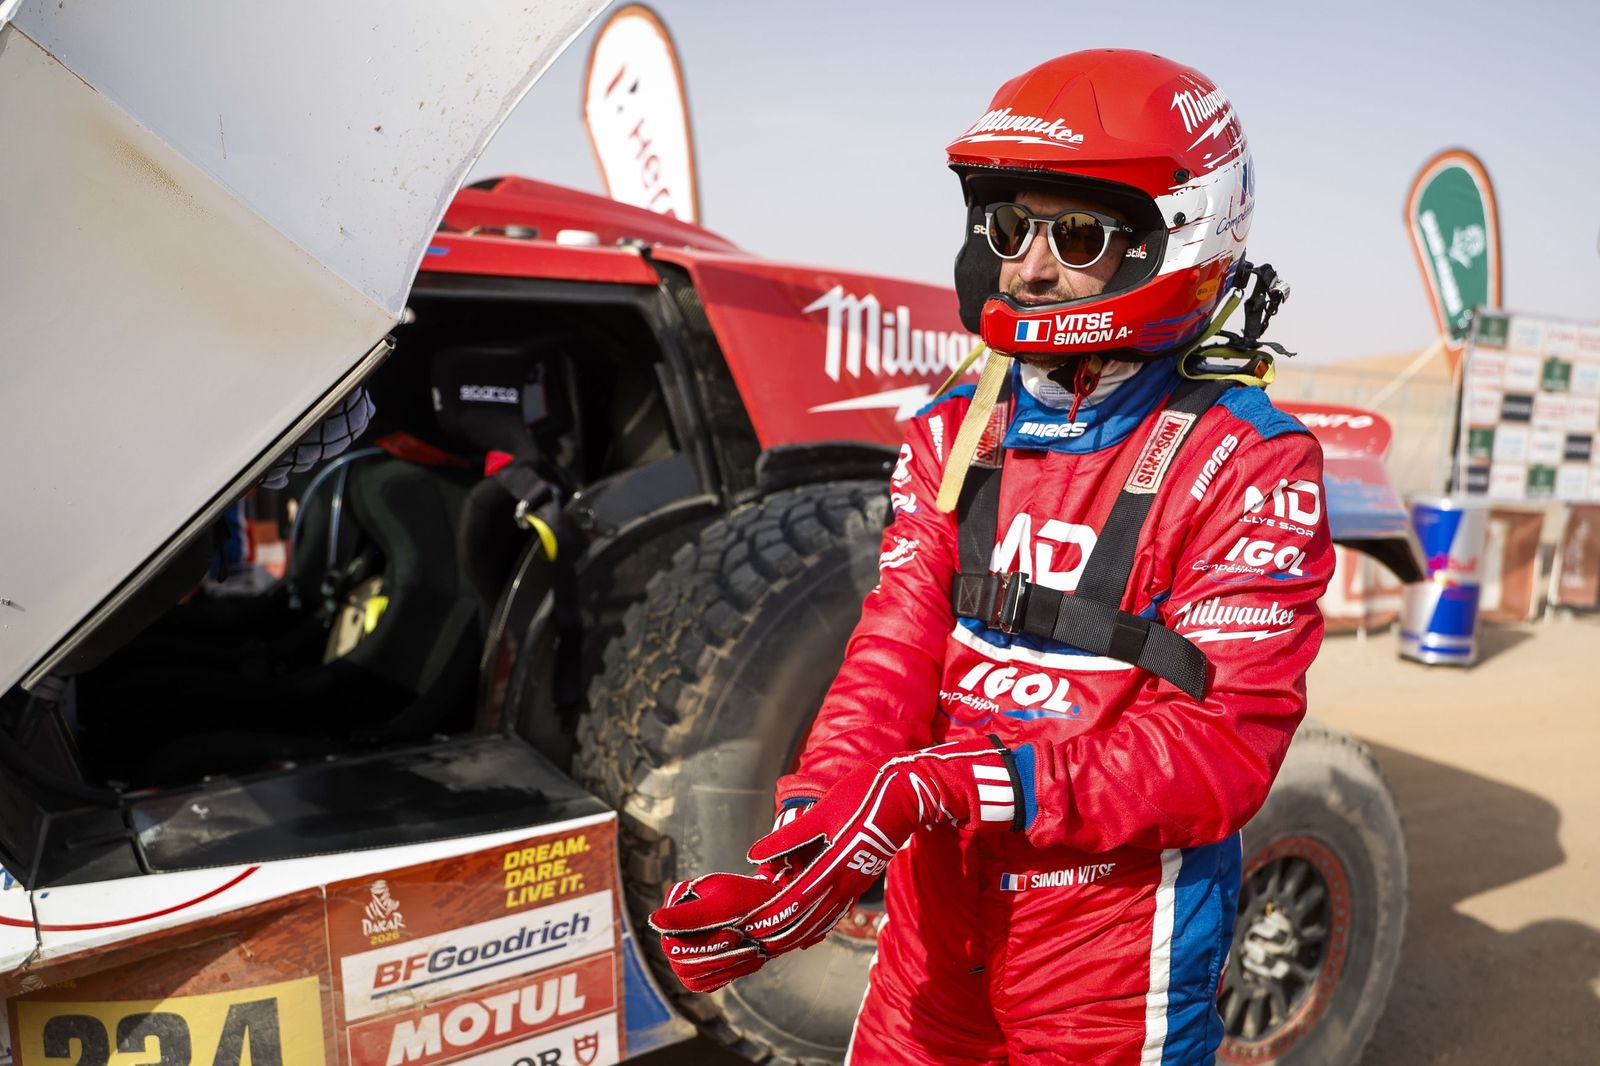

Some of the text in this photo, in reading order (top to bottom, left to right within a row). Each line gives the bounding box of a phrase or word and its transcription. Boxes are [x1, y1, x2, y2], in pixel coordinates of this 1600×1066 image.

[959, 107, 1084, 144] Milwaukee
[1053, 326, 1134, 345] SIMON A-
[1055, 312, 1114, 331] VITSE
[1137, 421, 1181, 485] SIMPSON
[1240, 515, 1315, 537] LLYE SPOR
[1224, 536, 1306, 577] IGOL
[1174, 597, 1295, 630] Milwaukee
[957, 661, 1073, 713] IGOL
[503, 835, 591, 870] DREAM.
[503, 859, 571, 889] DARE.
[505, 874, 585, 908] LIVE IT.
[1030, 862, 1116, 889] SIMON VITSE
[373, 912, 590, 989] BFGoodrich
[386, 972, 586, 1066] MOTUL
